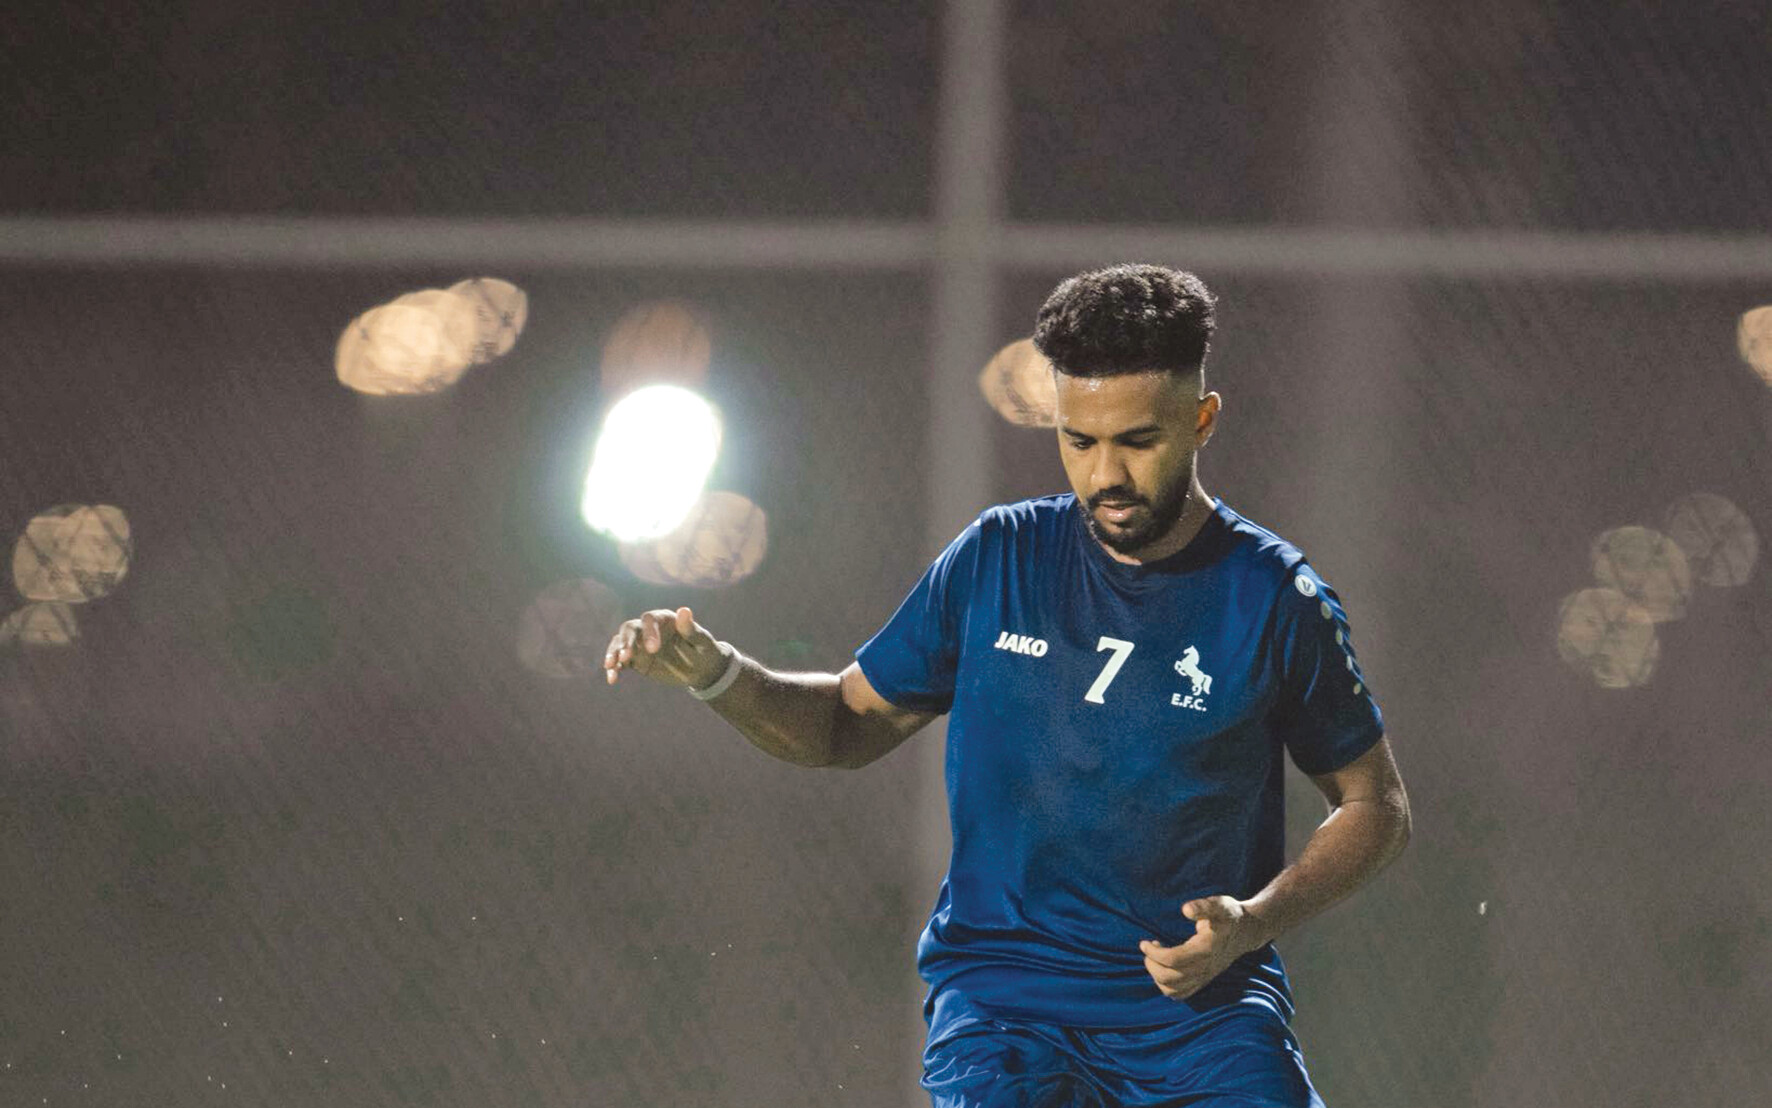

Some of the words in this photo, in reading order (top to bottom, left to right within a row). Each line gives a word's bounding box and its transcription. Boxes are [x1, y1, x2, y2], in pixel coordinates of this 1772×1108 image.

[994, 631, 1049, 657] JAKO
[1084, 636, 1135, 704] 7
[1170, 693, 1207, 711] E.F.C.
